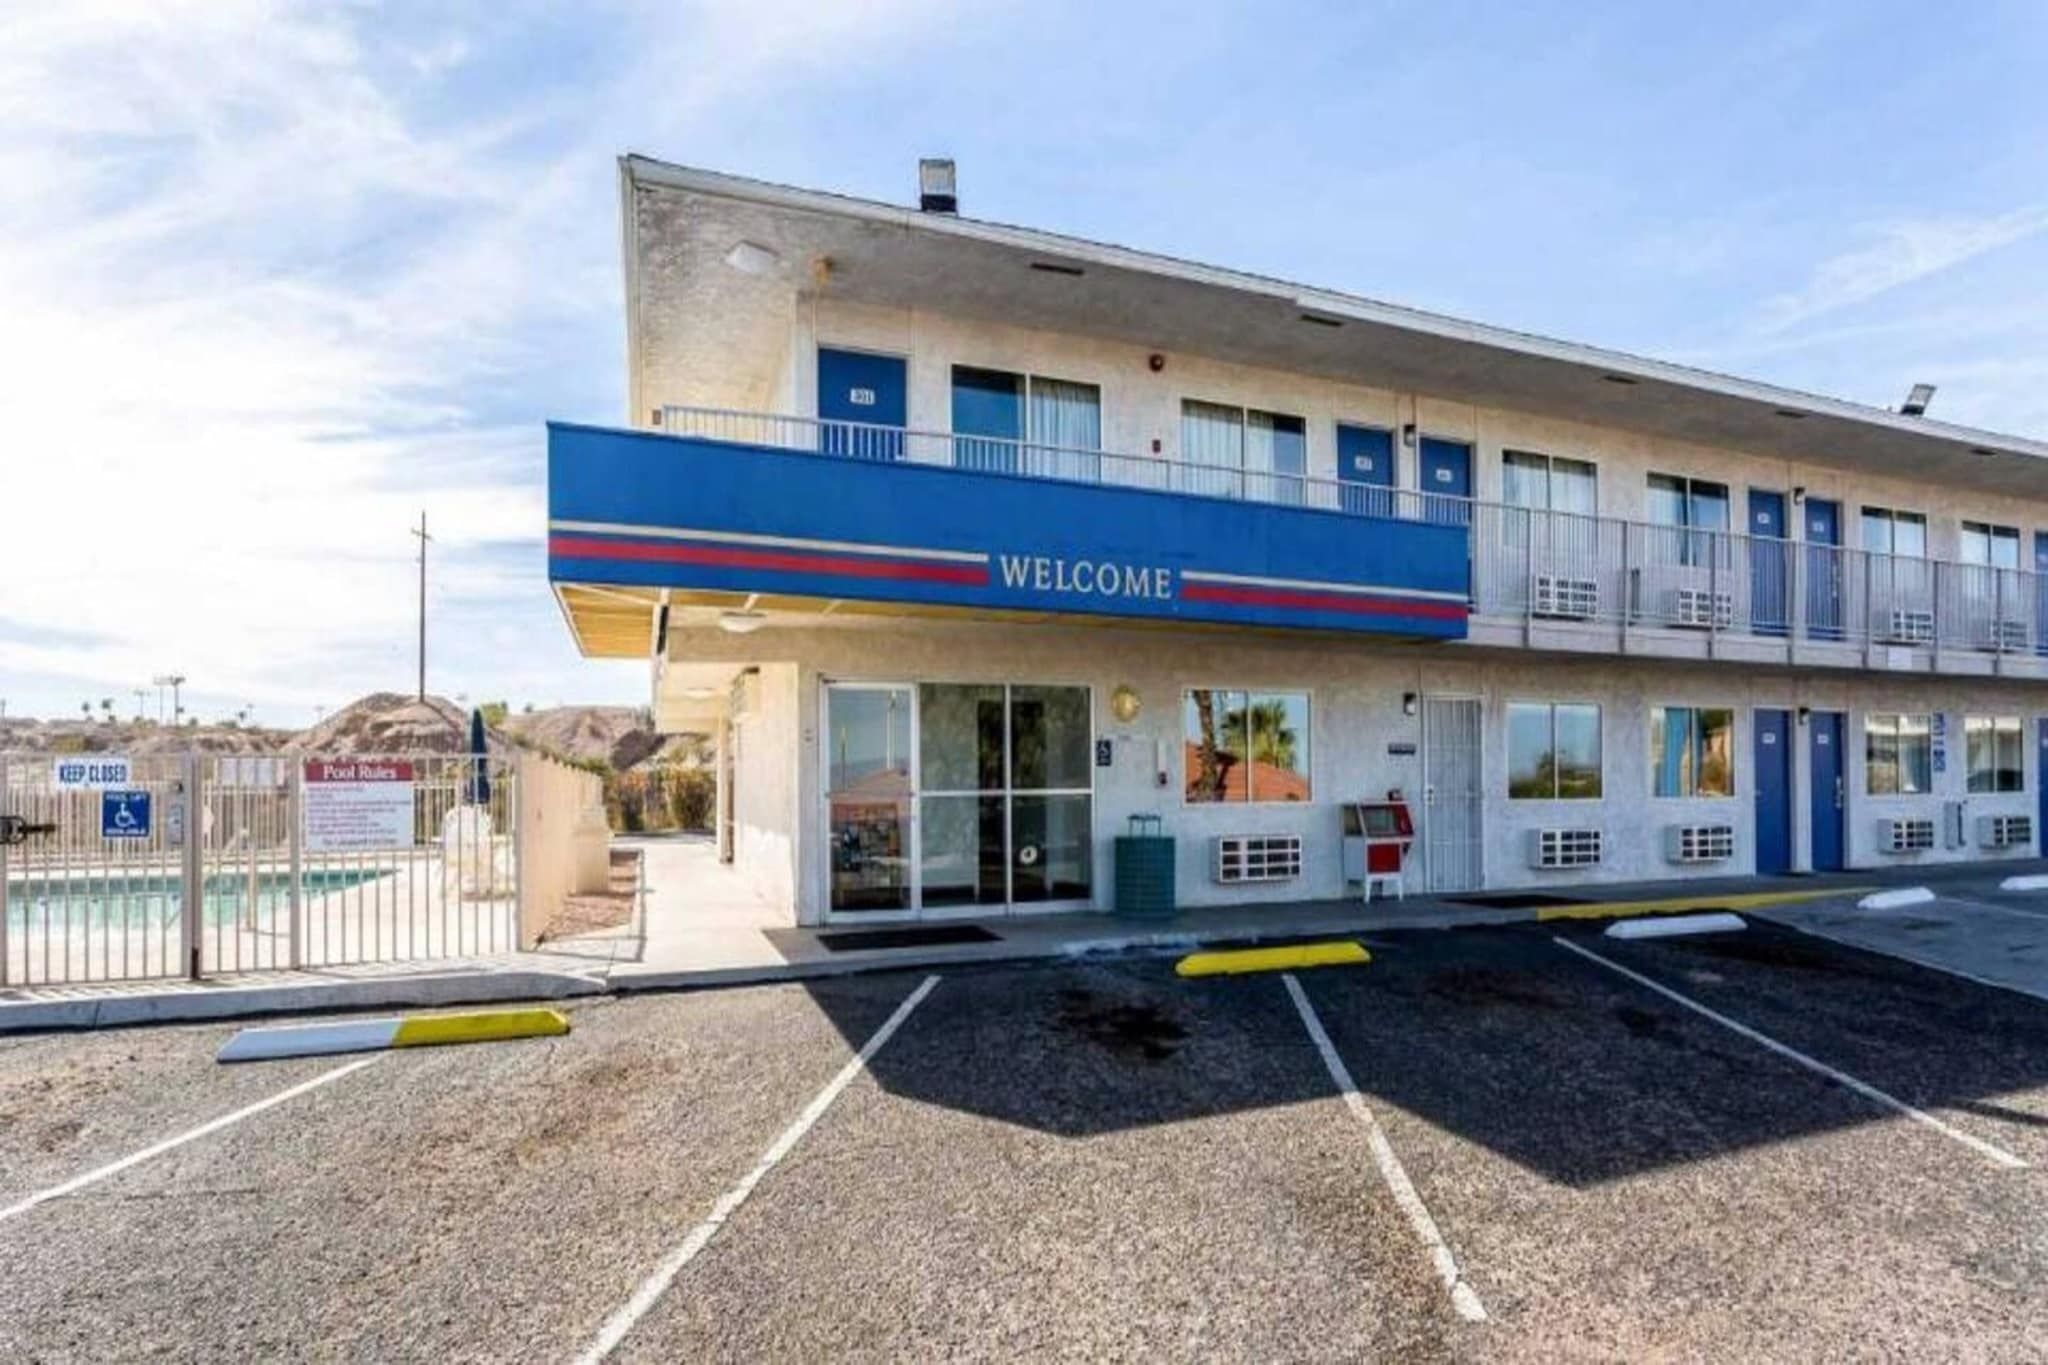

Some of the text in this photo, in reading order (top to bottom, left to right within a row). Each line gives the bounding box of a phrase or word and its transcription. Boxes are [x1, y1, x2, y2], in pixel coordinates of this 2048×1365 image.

[1000, 555, 1172, 599] WELCOME
[59, 764, 127, 782] KEEP CLOSED
[323, 764, 397, 779] Pool Rules
